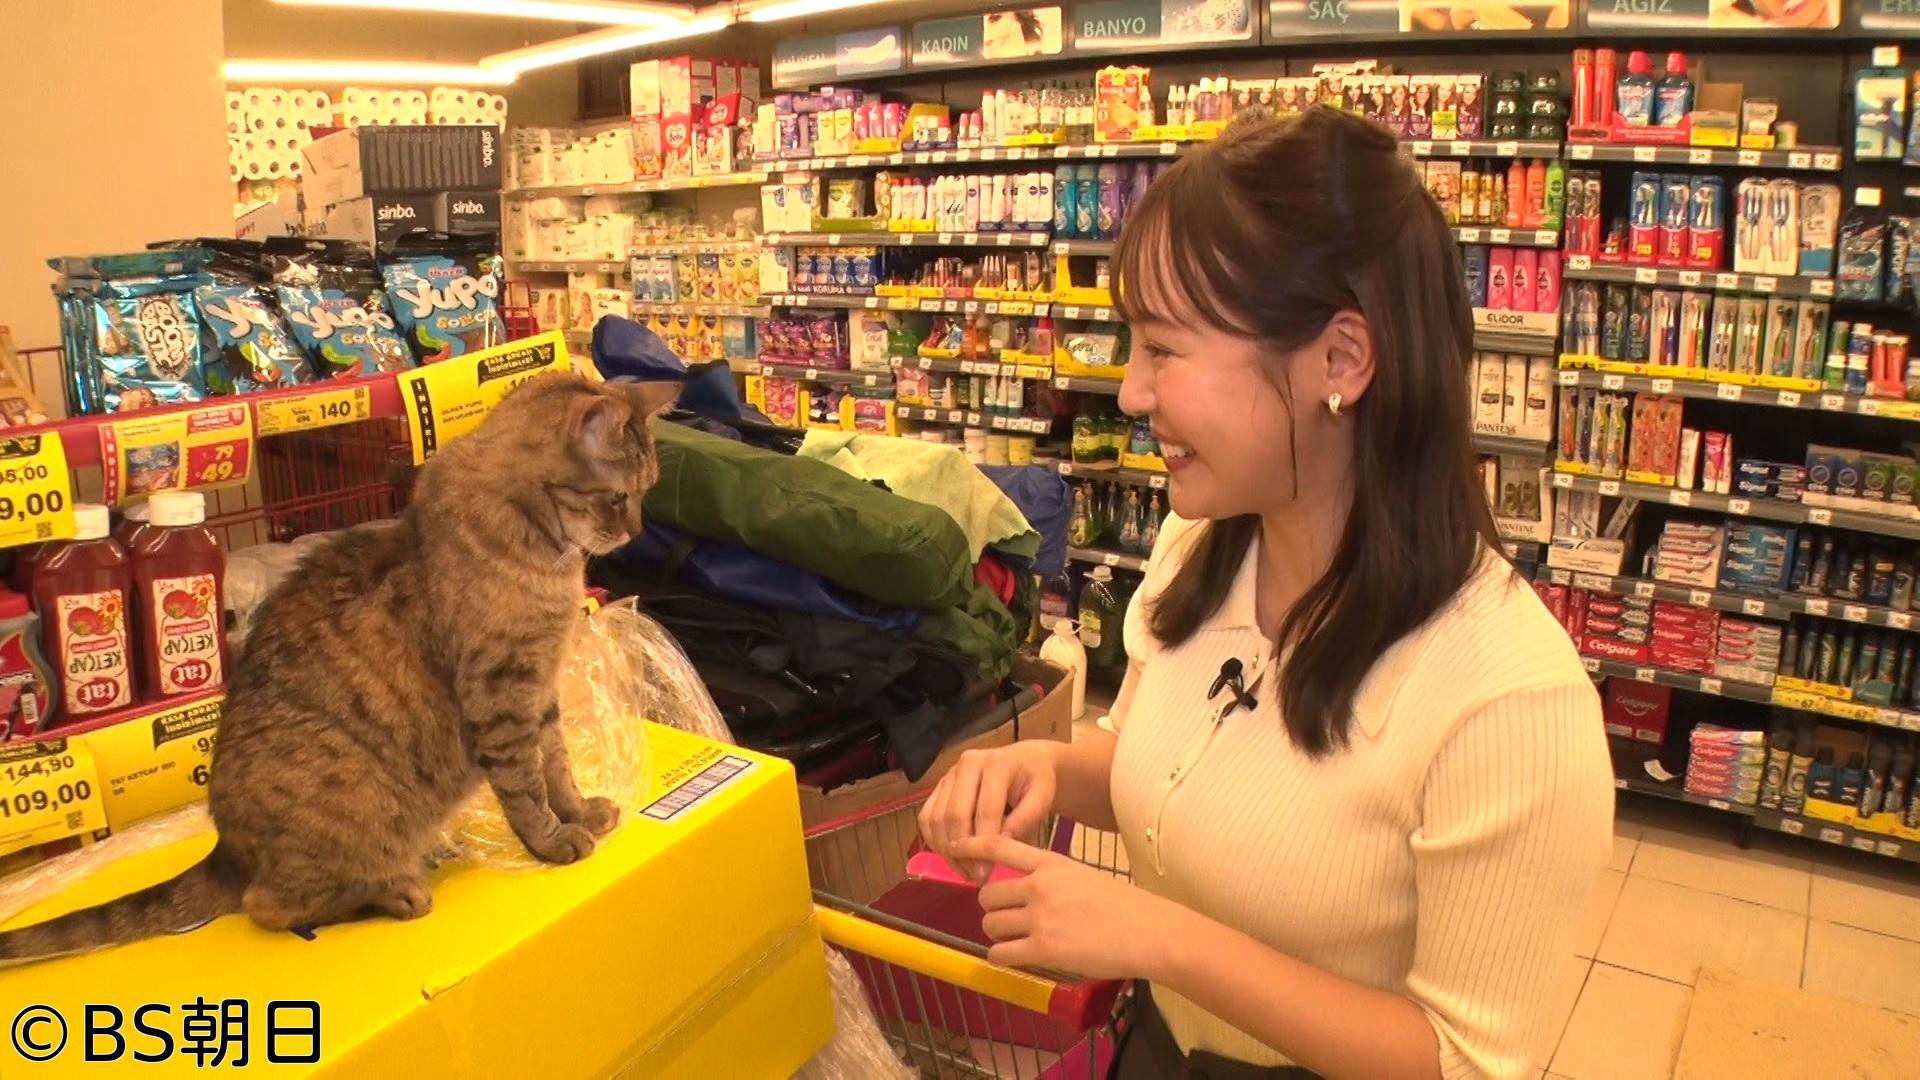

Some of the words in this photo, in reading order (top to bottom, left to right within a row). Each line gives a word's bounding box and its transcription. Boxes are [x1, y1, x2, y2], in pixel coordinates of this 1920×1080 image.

[1308, 0, 1349, 23] SAÇ
[1083, 17, 1146, 37] BANYO
[921, 35, 968, 54] KADIN
[320, 401, 351, 419] 140
[200, 460, 234, 482] 49
[1589, 639, 1639, 656] Colgate
[176, 664, 209, 684] tat
[81, 682, 117, 704] tat
[5, 755, 74, 781] 144,90
[0, 779, 91, 818] 109,00
